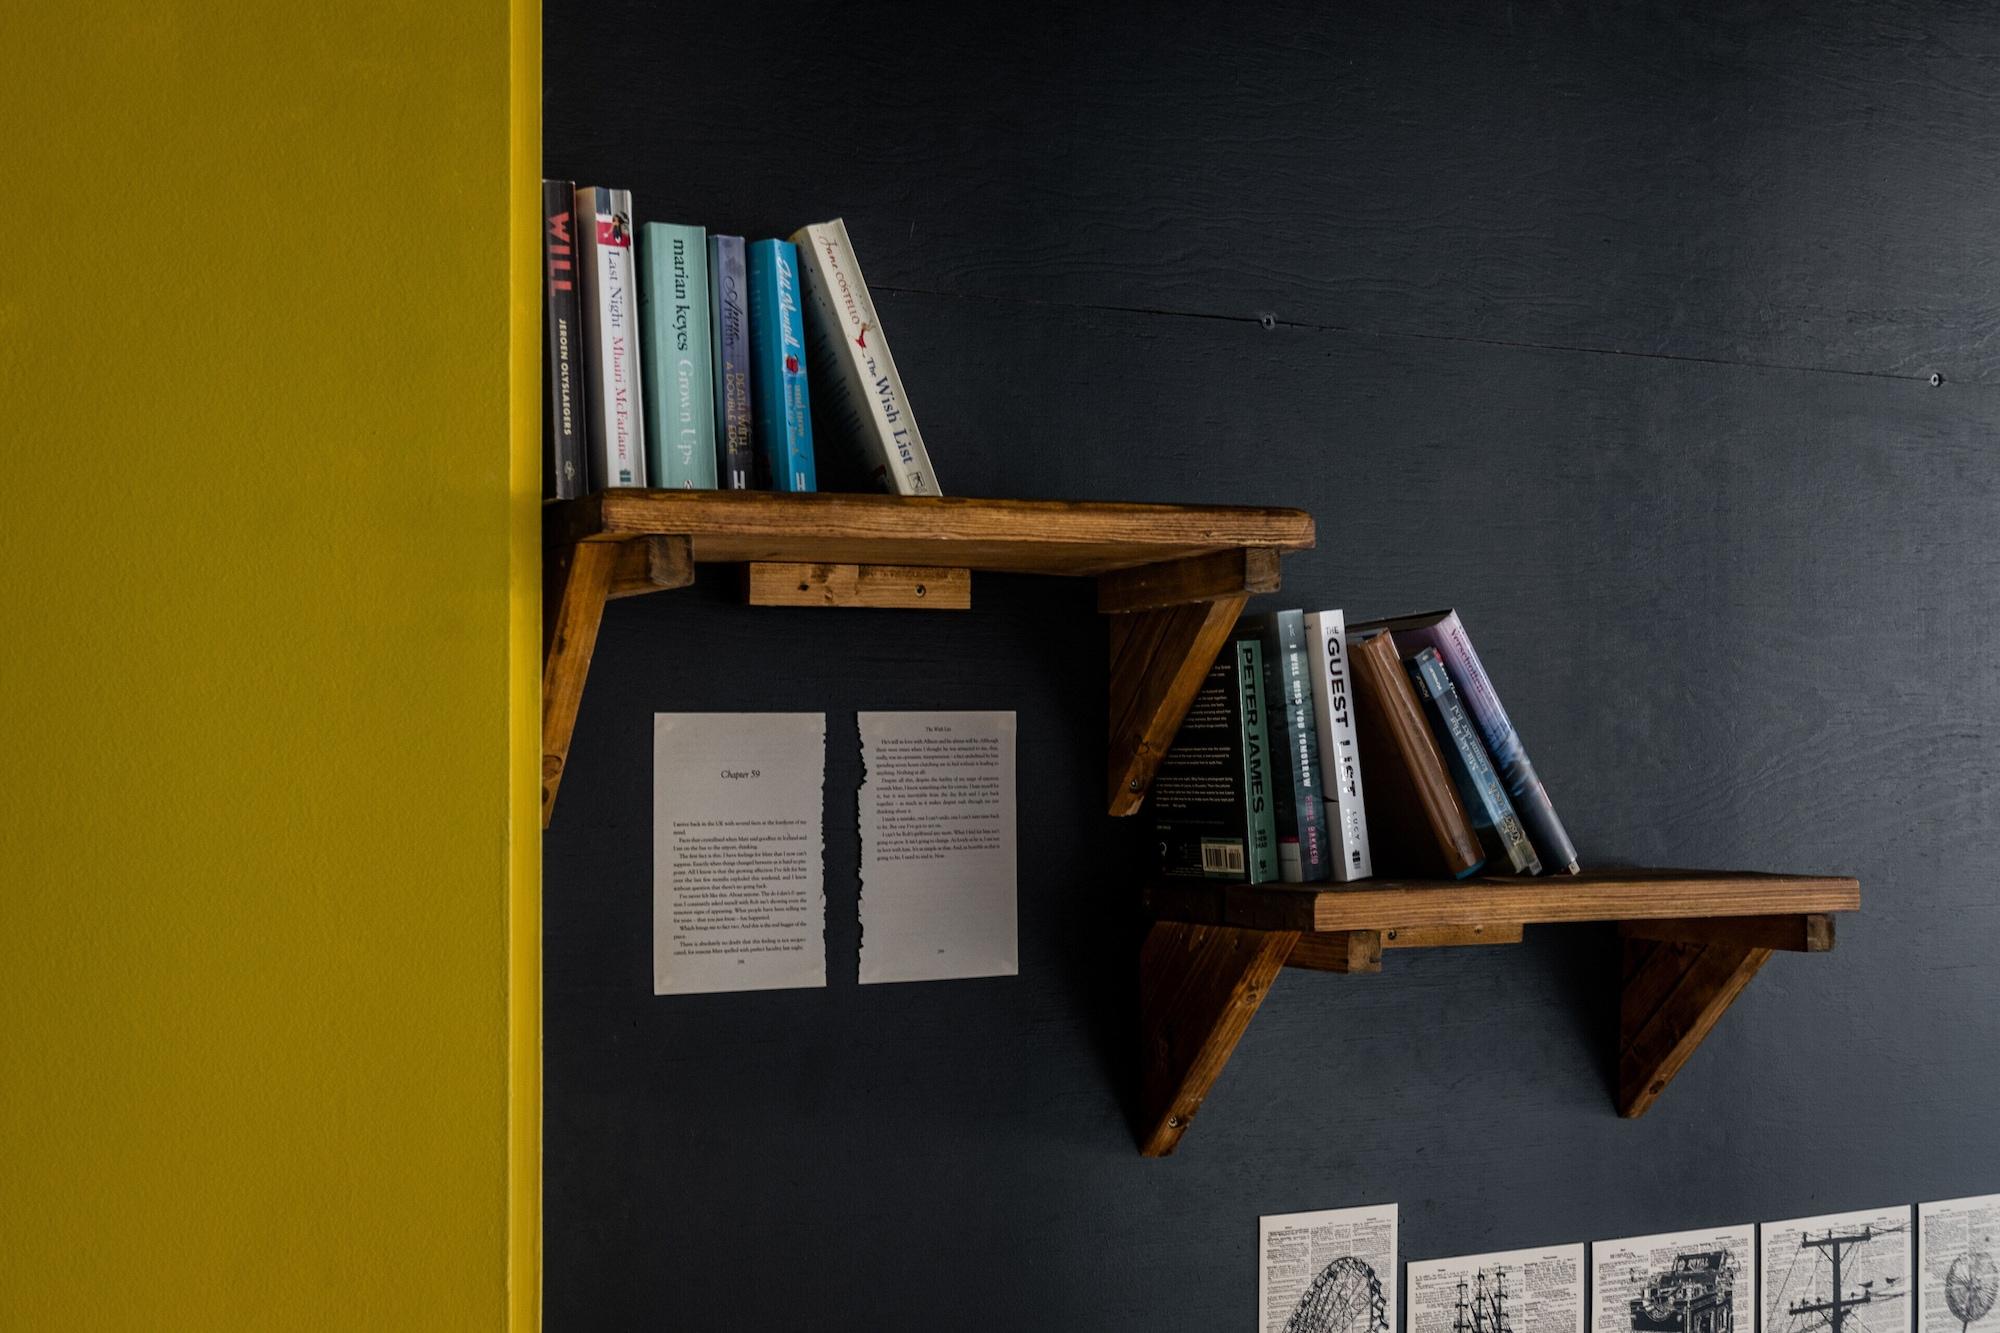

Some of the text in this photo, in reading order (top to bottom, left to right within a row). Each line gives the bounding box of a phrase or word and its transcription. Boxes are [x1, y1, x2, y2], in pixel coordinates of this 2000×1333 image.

[546, 212, 572, 297] WILL
[818, 235, 860, 325] Jane COSTELLO
[608, 251, 630, 460] Last Night Mhairi McFarlane
[673, 239, 698, 465] marian keyes Grown Ups
[779, 290, 800, 347] Mansell
[558, 319, 572, 435] JEROEN OLYSLAEGERS
[726, 362, 738, 455] A DOUBLE EDGE
[735, 373, 747, 446] DEATH WITH
[866, 358, 915, 464] The Wish List
[1290, 652, 1300, 676] WILL
[1326, 626, 1340, 635] THE
[1242, 648, 1264, 814] PETER JAMES
[1292, 679, 1303, 706] MISS
[1296, 708, 1306, 729] YOU
[1328, 638, 1357, 798] GUEST LIST
[720, 769, 760, 779] Chapter 59
[1297, 732, 1312, 788] TOMORROW
[1352, 811, 1361, 841] LUCY
